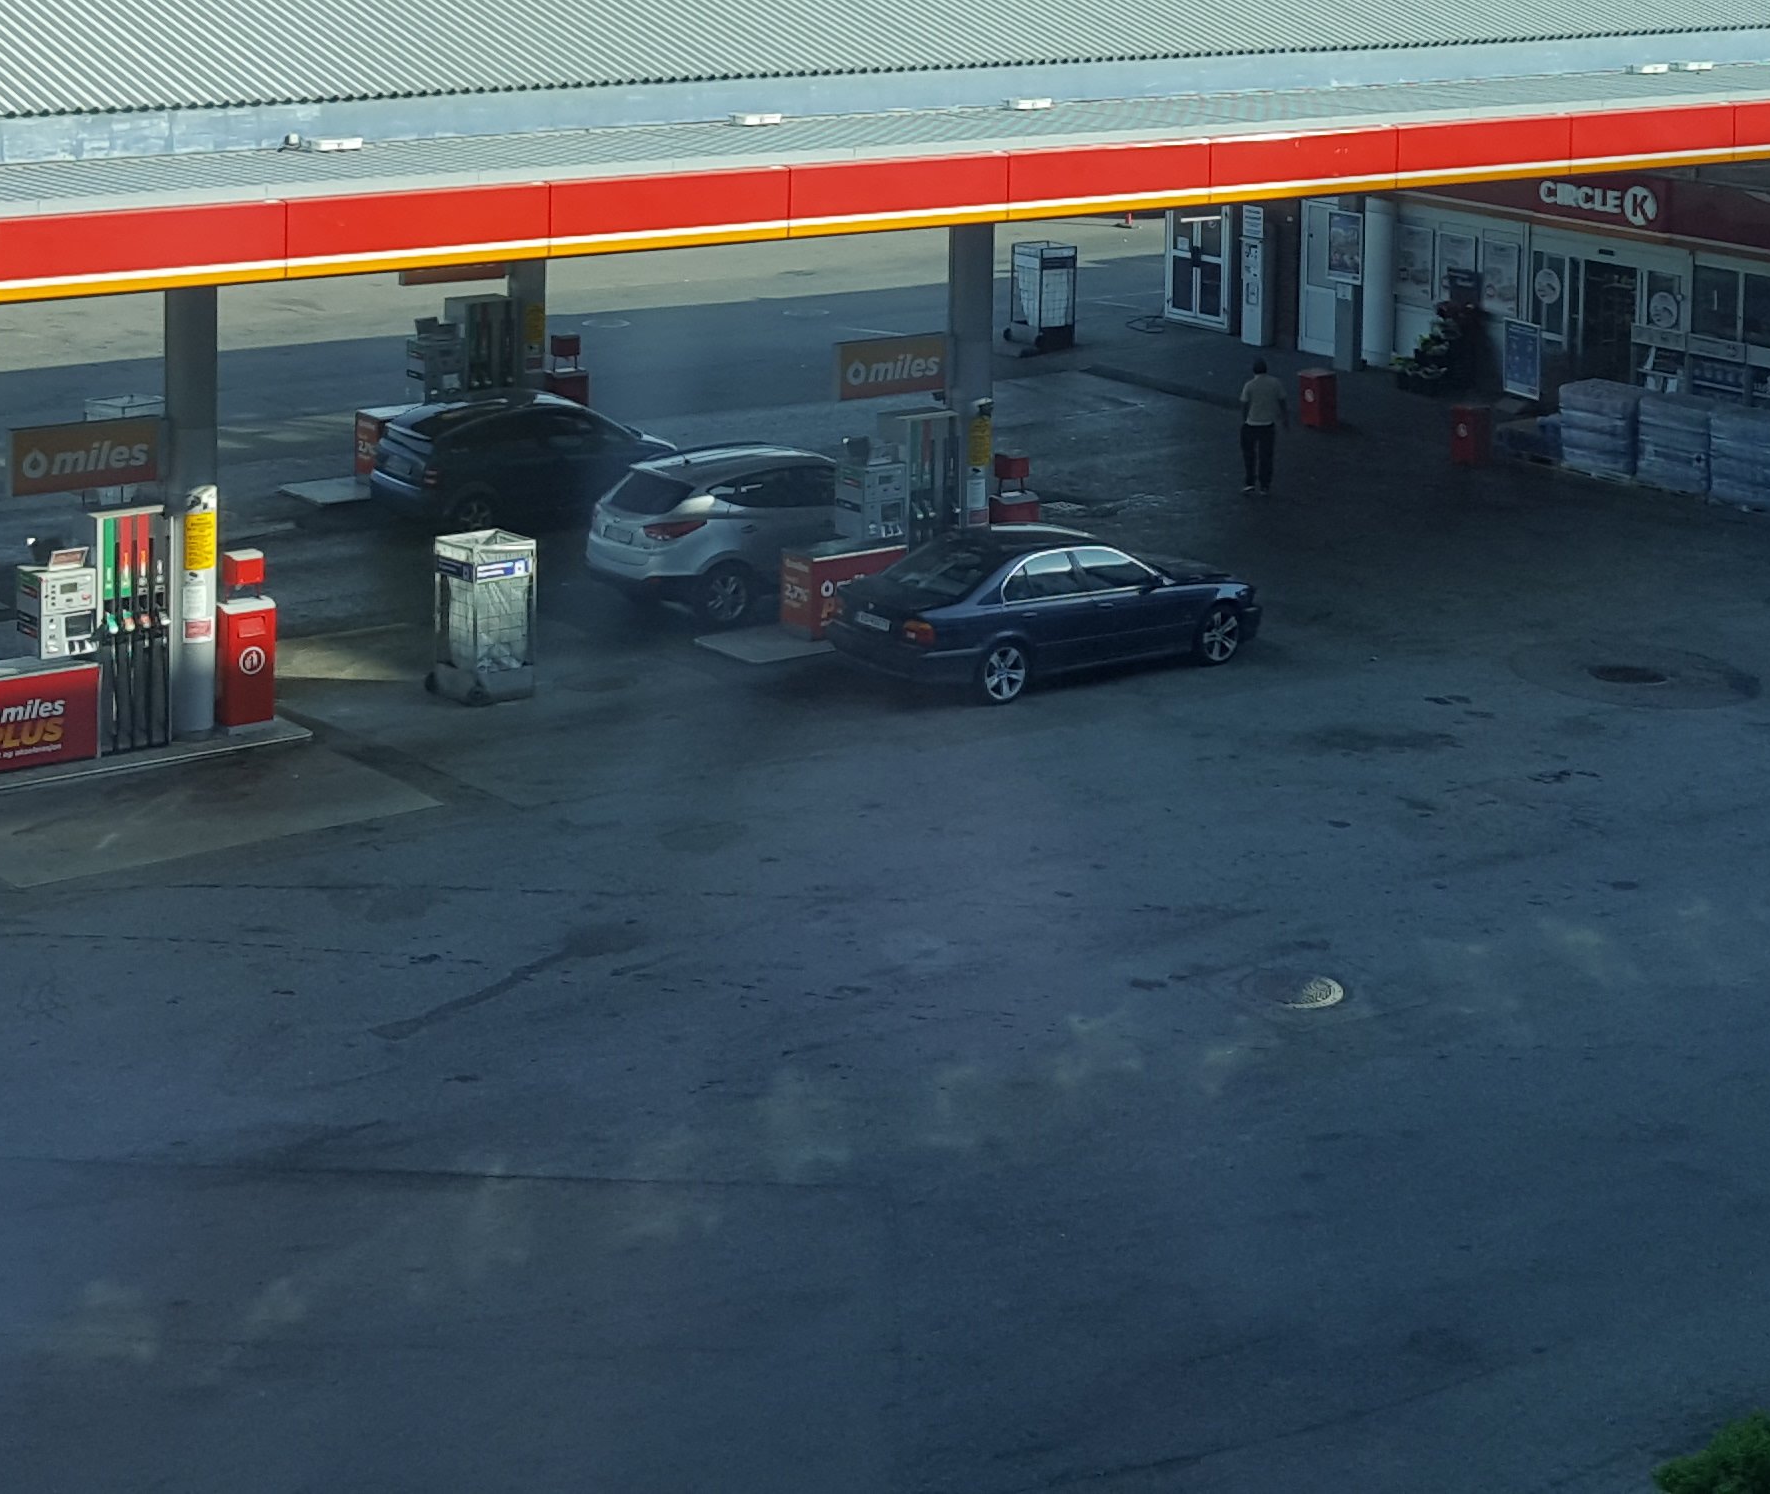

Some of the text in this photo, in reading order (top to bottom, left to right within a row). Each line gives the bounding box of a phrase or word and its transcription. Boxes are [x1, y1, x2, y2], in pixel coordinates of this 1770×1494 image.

[1539, 180, 1622, 214] CIRCLE
[868, 353, 941, 383] miles
[51, 439, 149, 476] miles
[1, 698, 67, 723] miles
